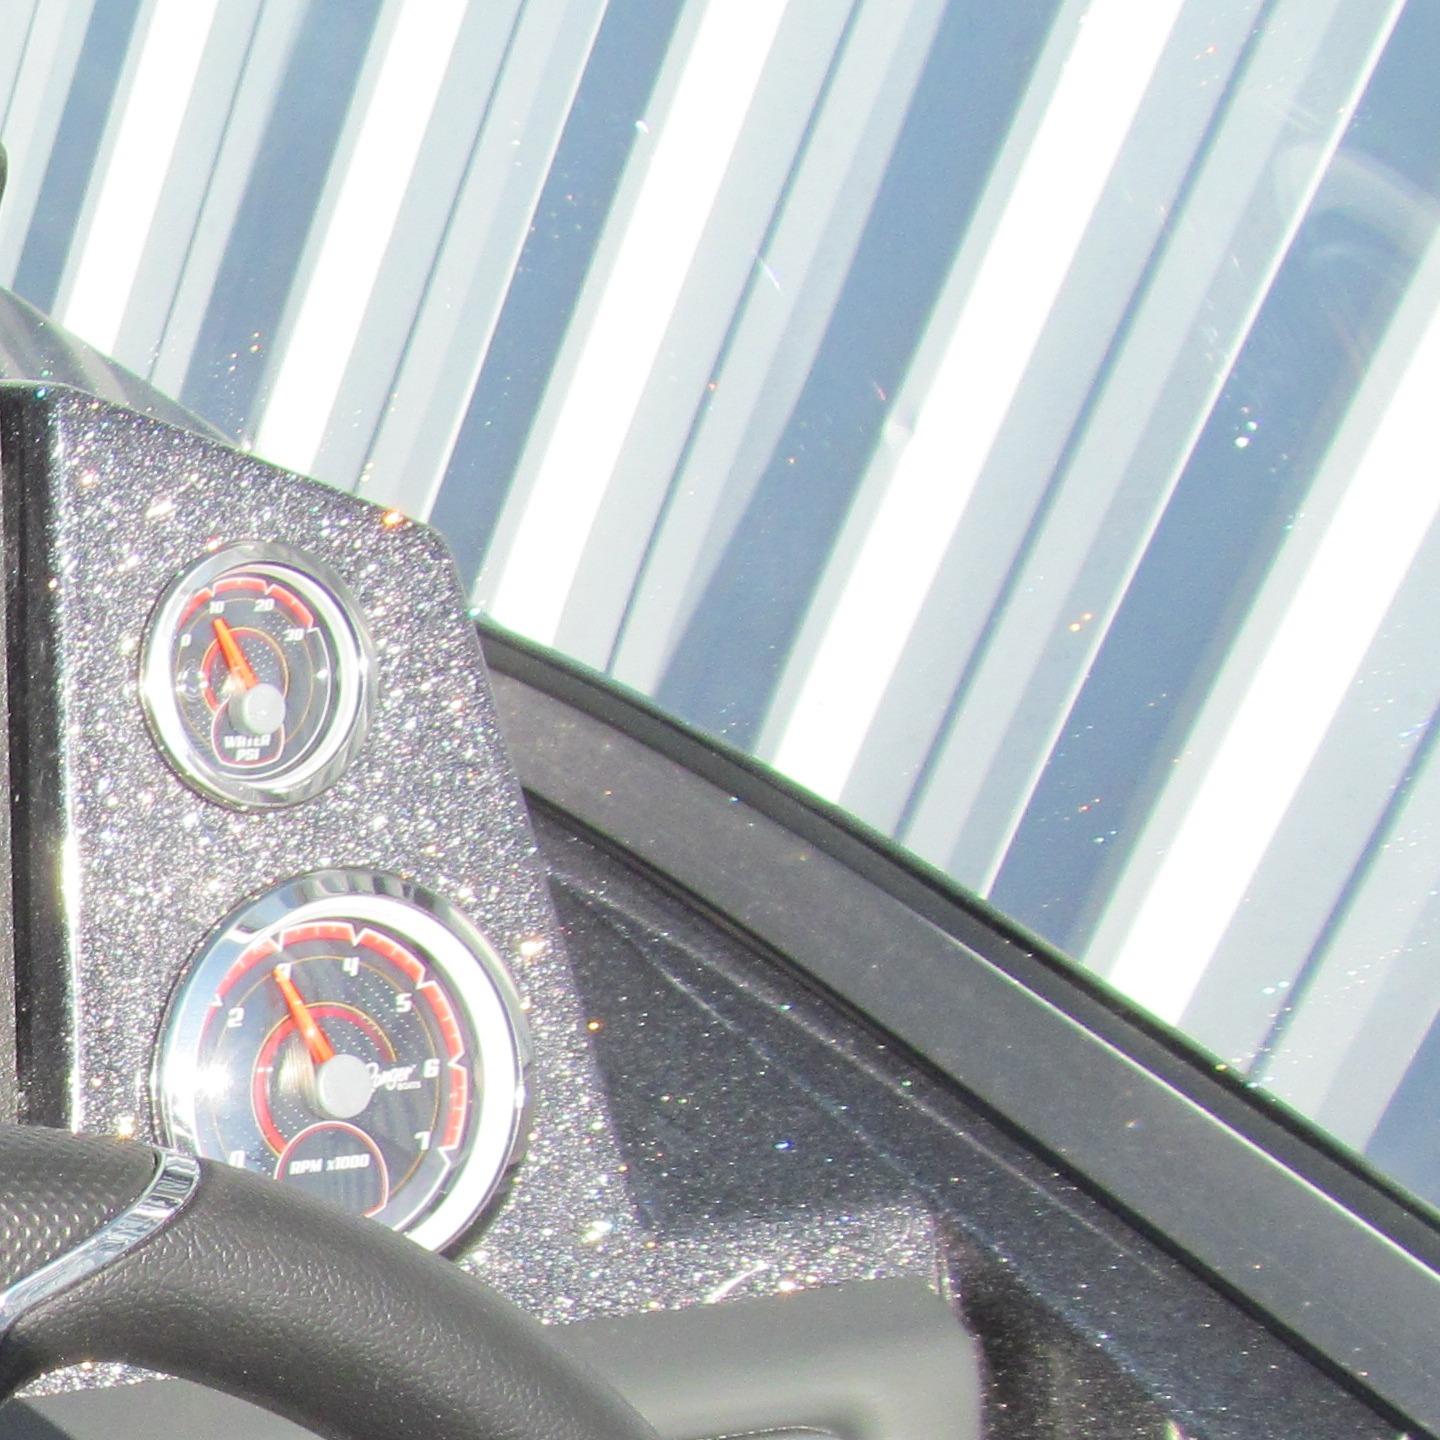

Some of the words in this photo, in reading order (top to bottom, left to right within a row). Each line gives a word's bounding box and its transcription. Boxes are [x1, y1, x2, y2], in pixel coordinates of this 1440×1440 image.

[209, 601, 225, 614] 10
[254, 599, 275, 612] 20
[180, 633, 192, 647] 0
[284, 628, 305, 642] 30
[224, 734, 271, 749] WATER
[235, 748, 260, 761] PSI
[343, 957, 359, 977] 4
[396, 993, 413, 1012] 5
[227, 1007, 245, 1028] 2
[424, 1058, 440, 1078] 6
[289, 1158, 323, 1175] RPM
